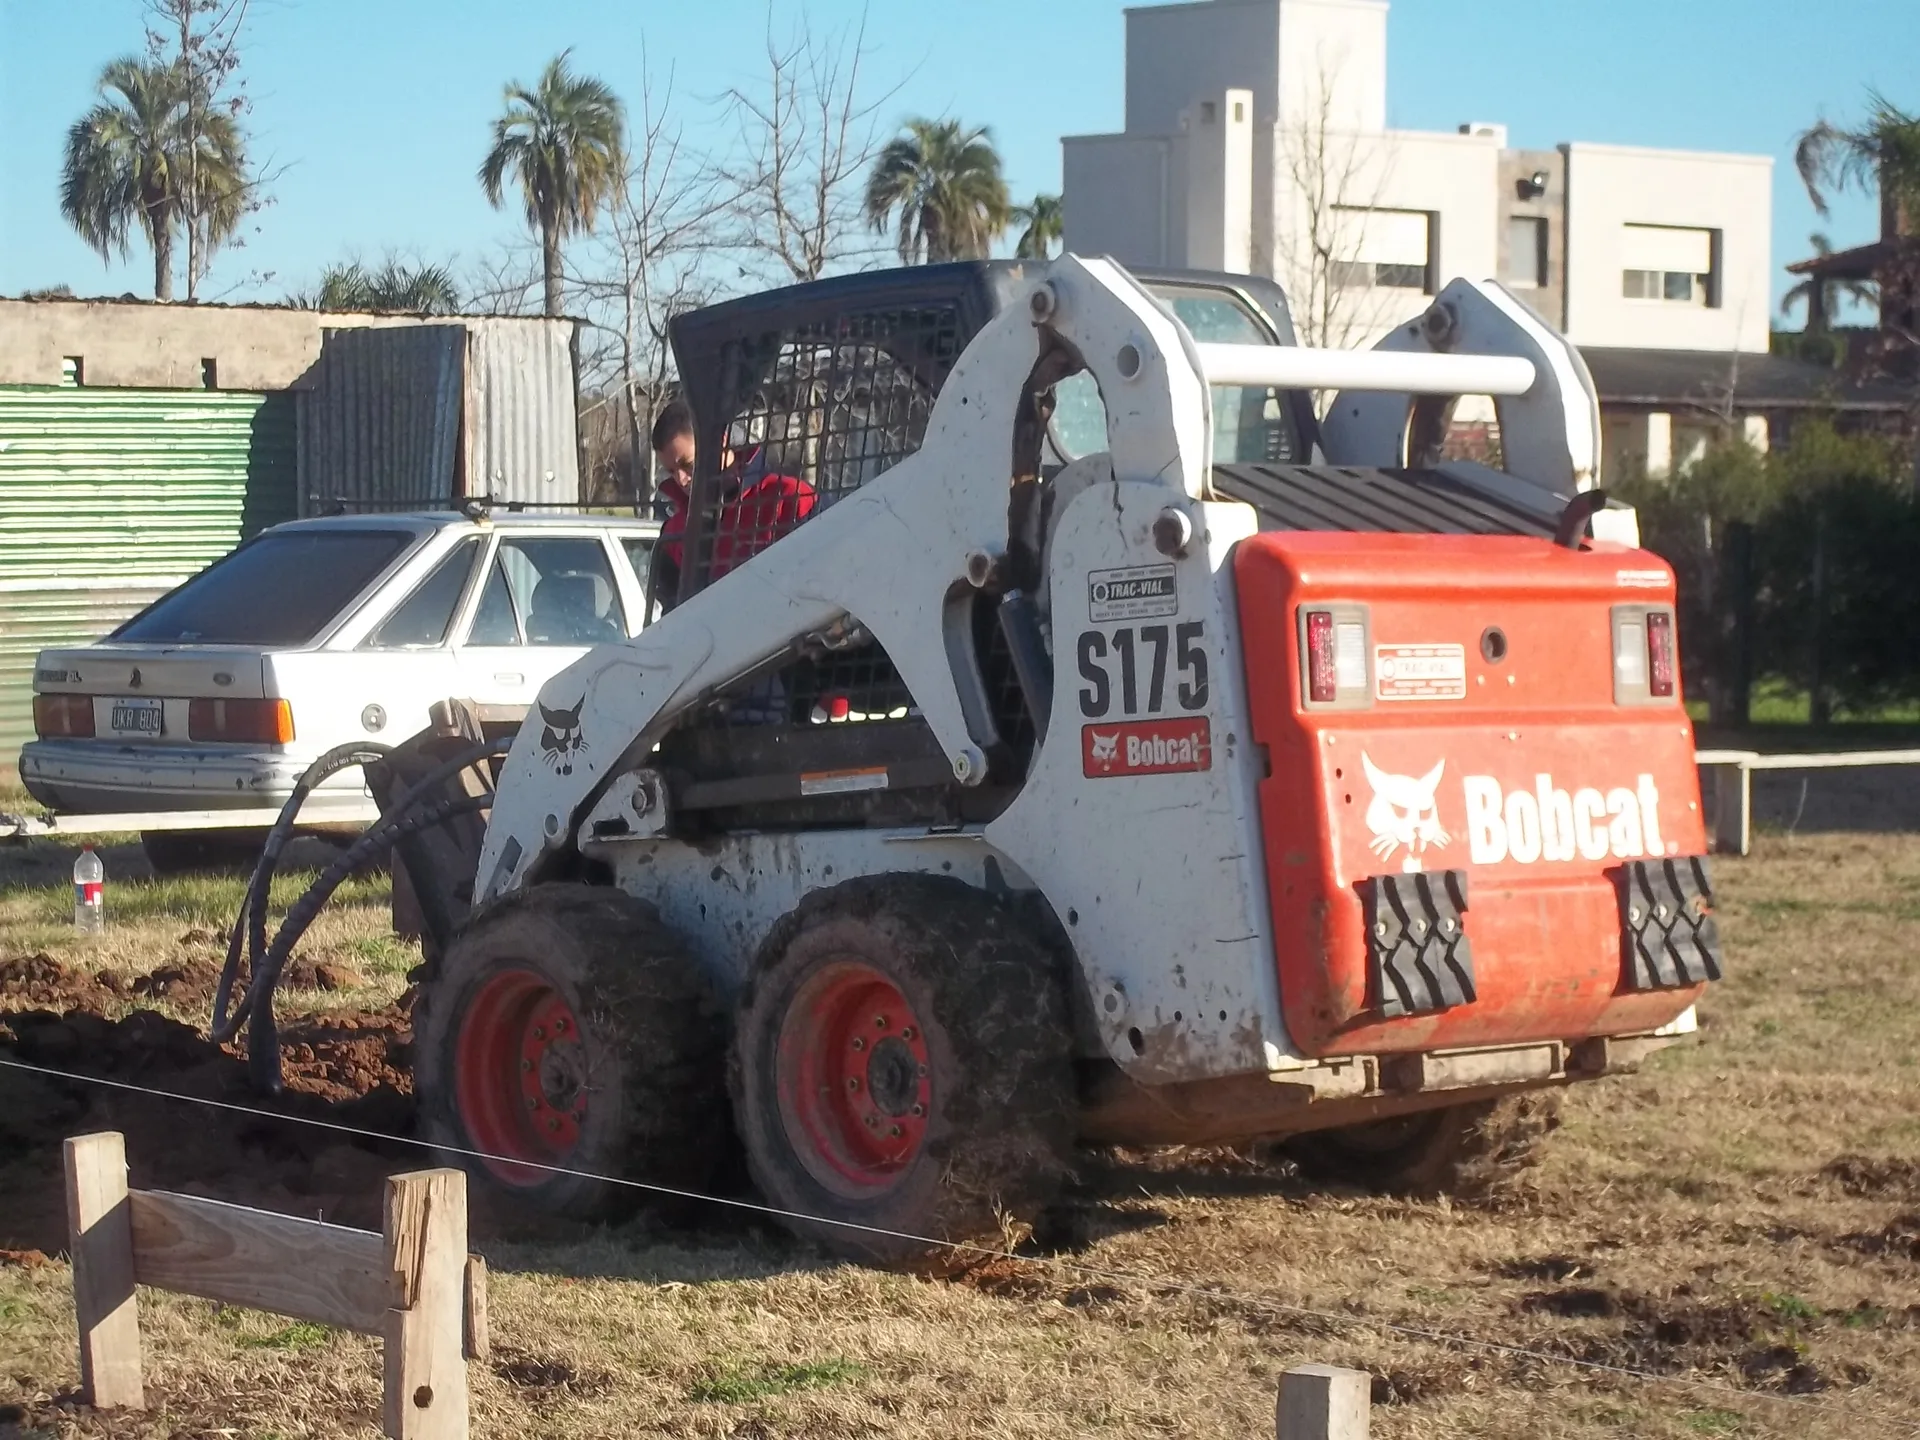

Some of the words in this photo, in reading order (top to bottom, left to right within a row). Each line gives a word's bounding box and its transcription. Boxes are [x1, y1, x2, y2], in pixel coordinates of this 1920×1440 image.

[1109, 580, 1164, 599] TRAC-VIAL
[1077, 621, 1210, 718] S175
[139, 708, 160, 730] 804
[1126, 732, 1199, 767] Bobcat
[1463, 773, 1665, 865] Bobcat
